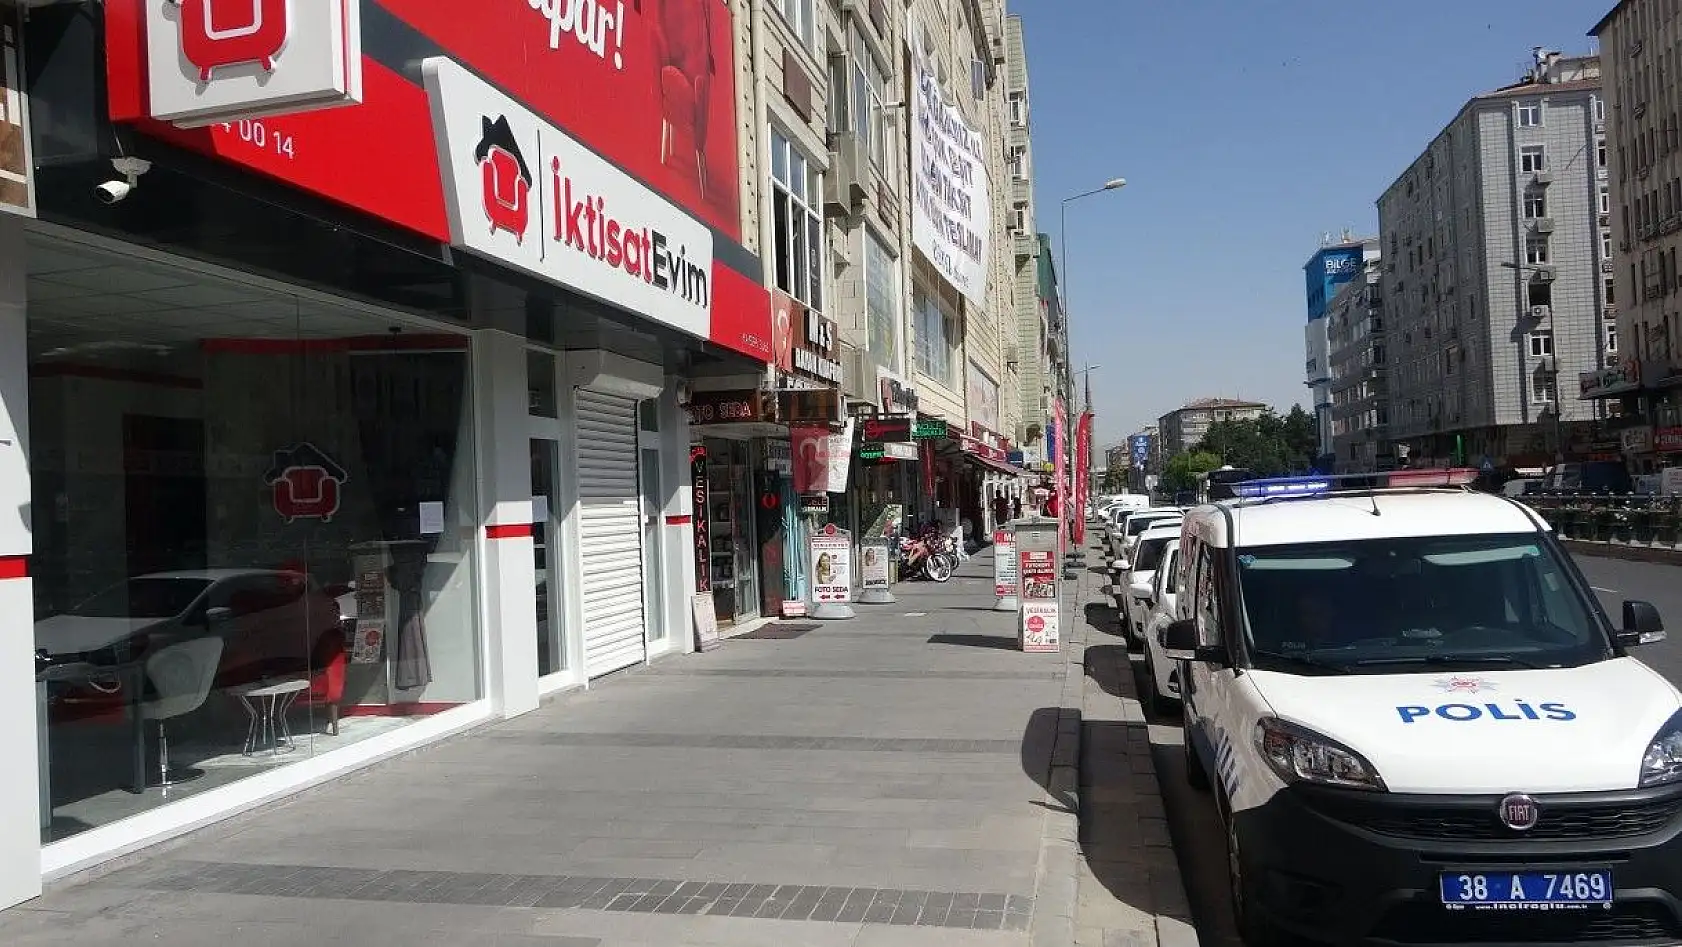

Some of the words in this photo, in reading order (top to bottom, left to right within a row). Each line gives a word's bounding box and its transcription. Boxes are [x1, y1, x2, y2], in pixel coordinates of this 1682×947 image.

[273, 131, 294, 160] 14
[1396, 699, 1577, 723] POLİS
[1508, 804, 1530, 821] FIAT
[1459, 874, 1488, 901] 38
[1510, 874, 1526, 900] A
[1543, 873, 1605, 900] 7469
